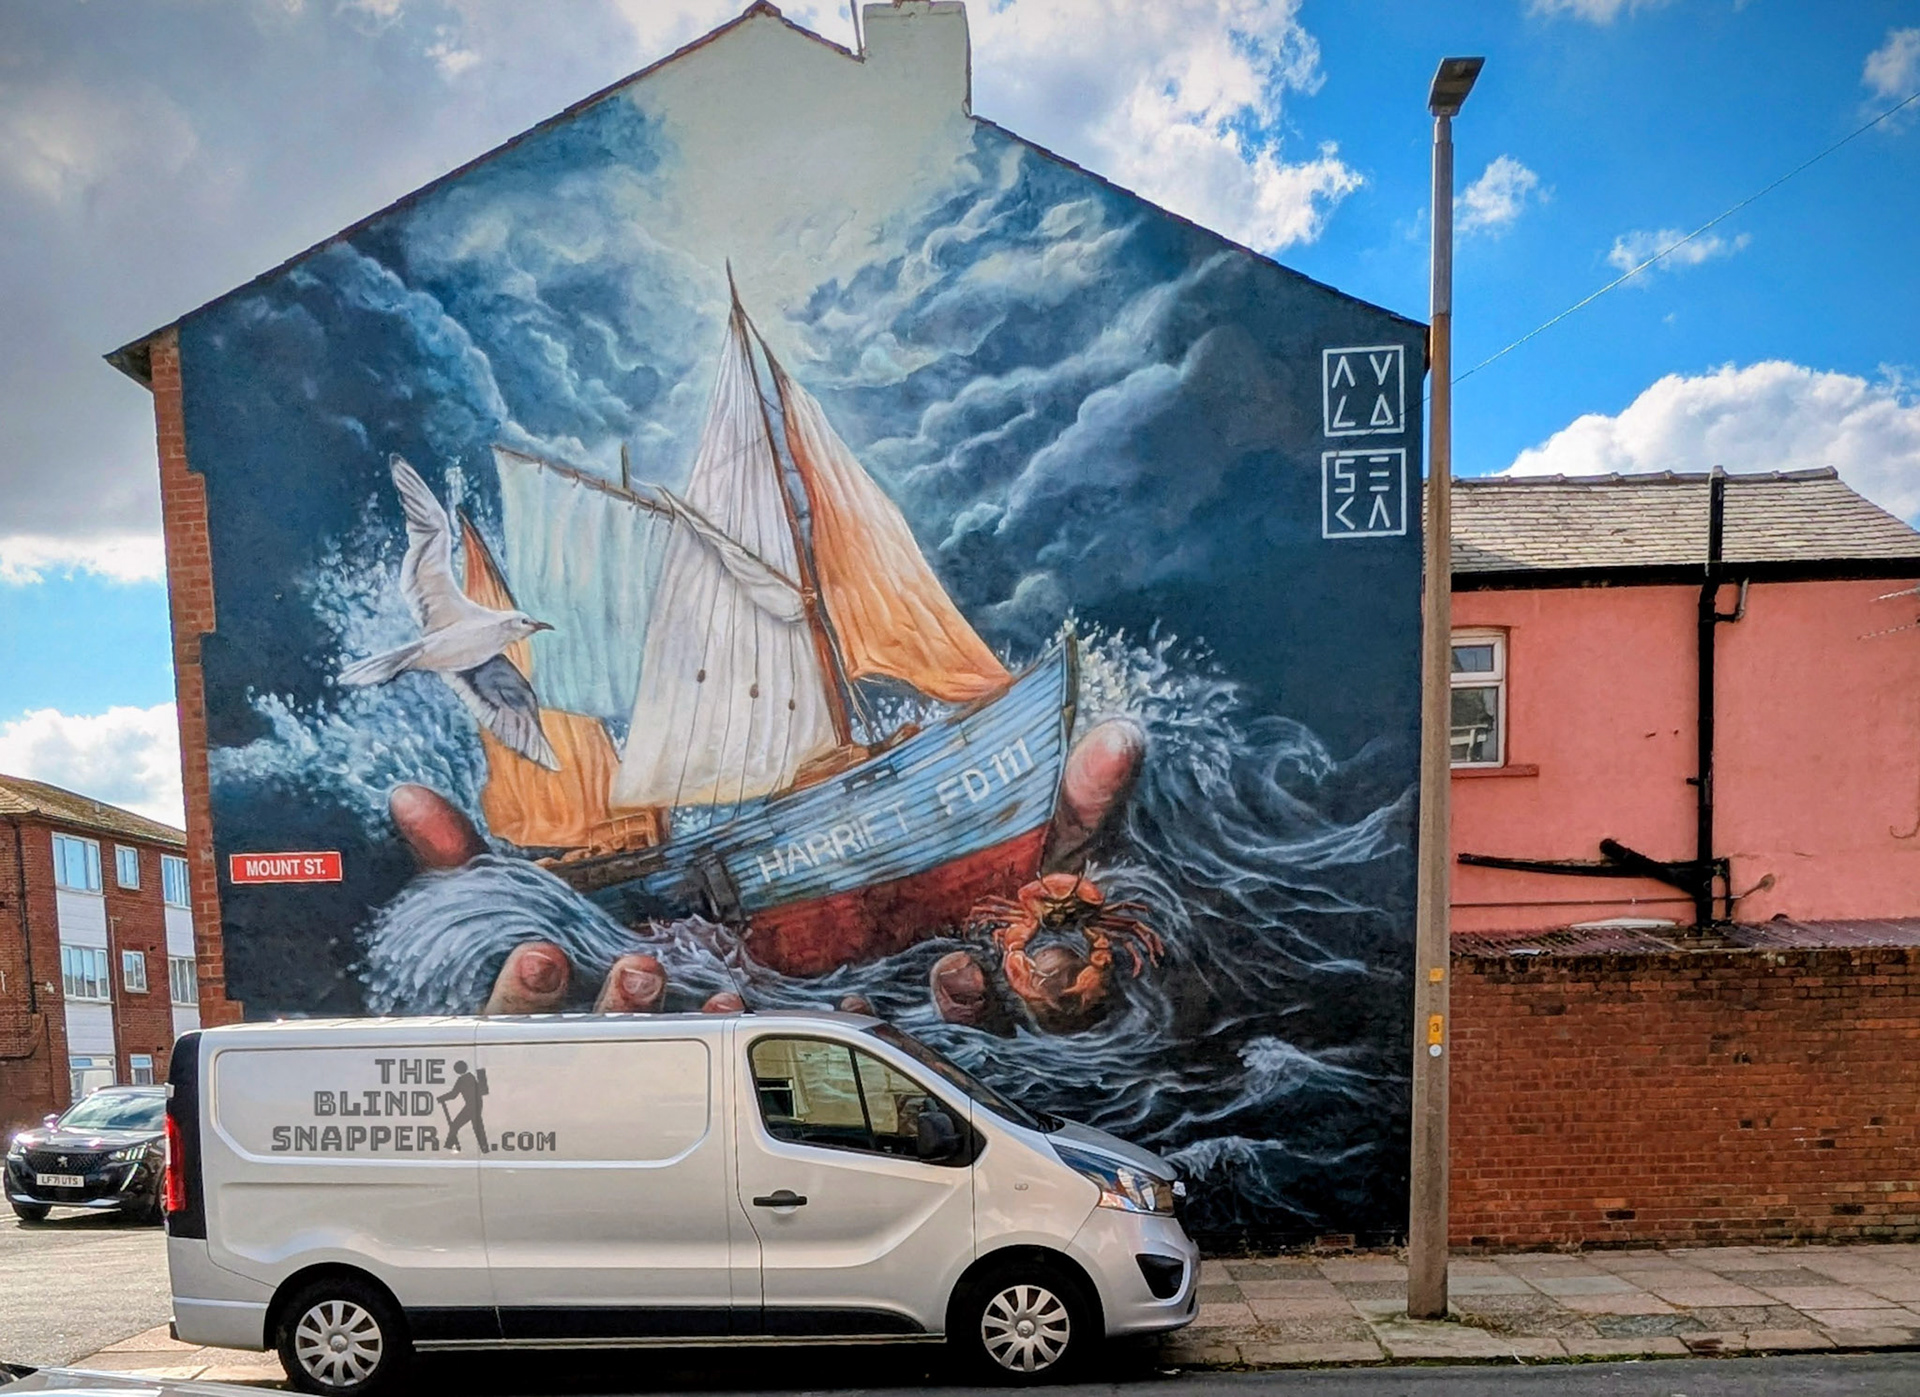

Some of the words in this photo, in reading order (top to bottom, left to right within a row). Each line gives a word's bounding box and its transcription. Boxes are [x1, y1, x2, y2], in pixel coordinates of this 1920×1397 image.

[756, 800, 910, 883] HARRIET
[246, 859, 301, 877] MOUNT
[304, 858, 326, 875] ST.
[1432, 1023, 1440, 1033] 3
